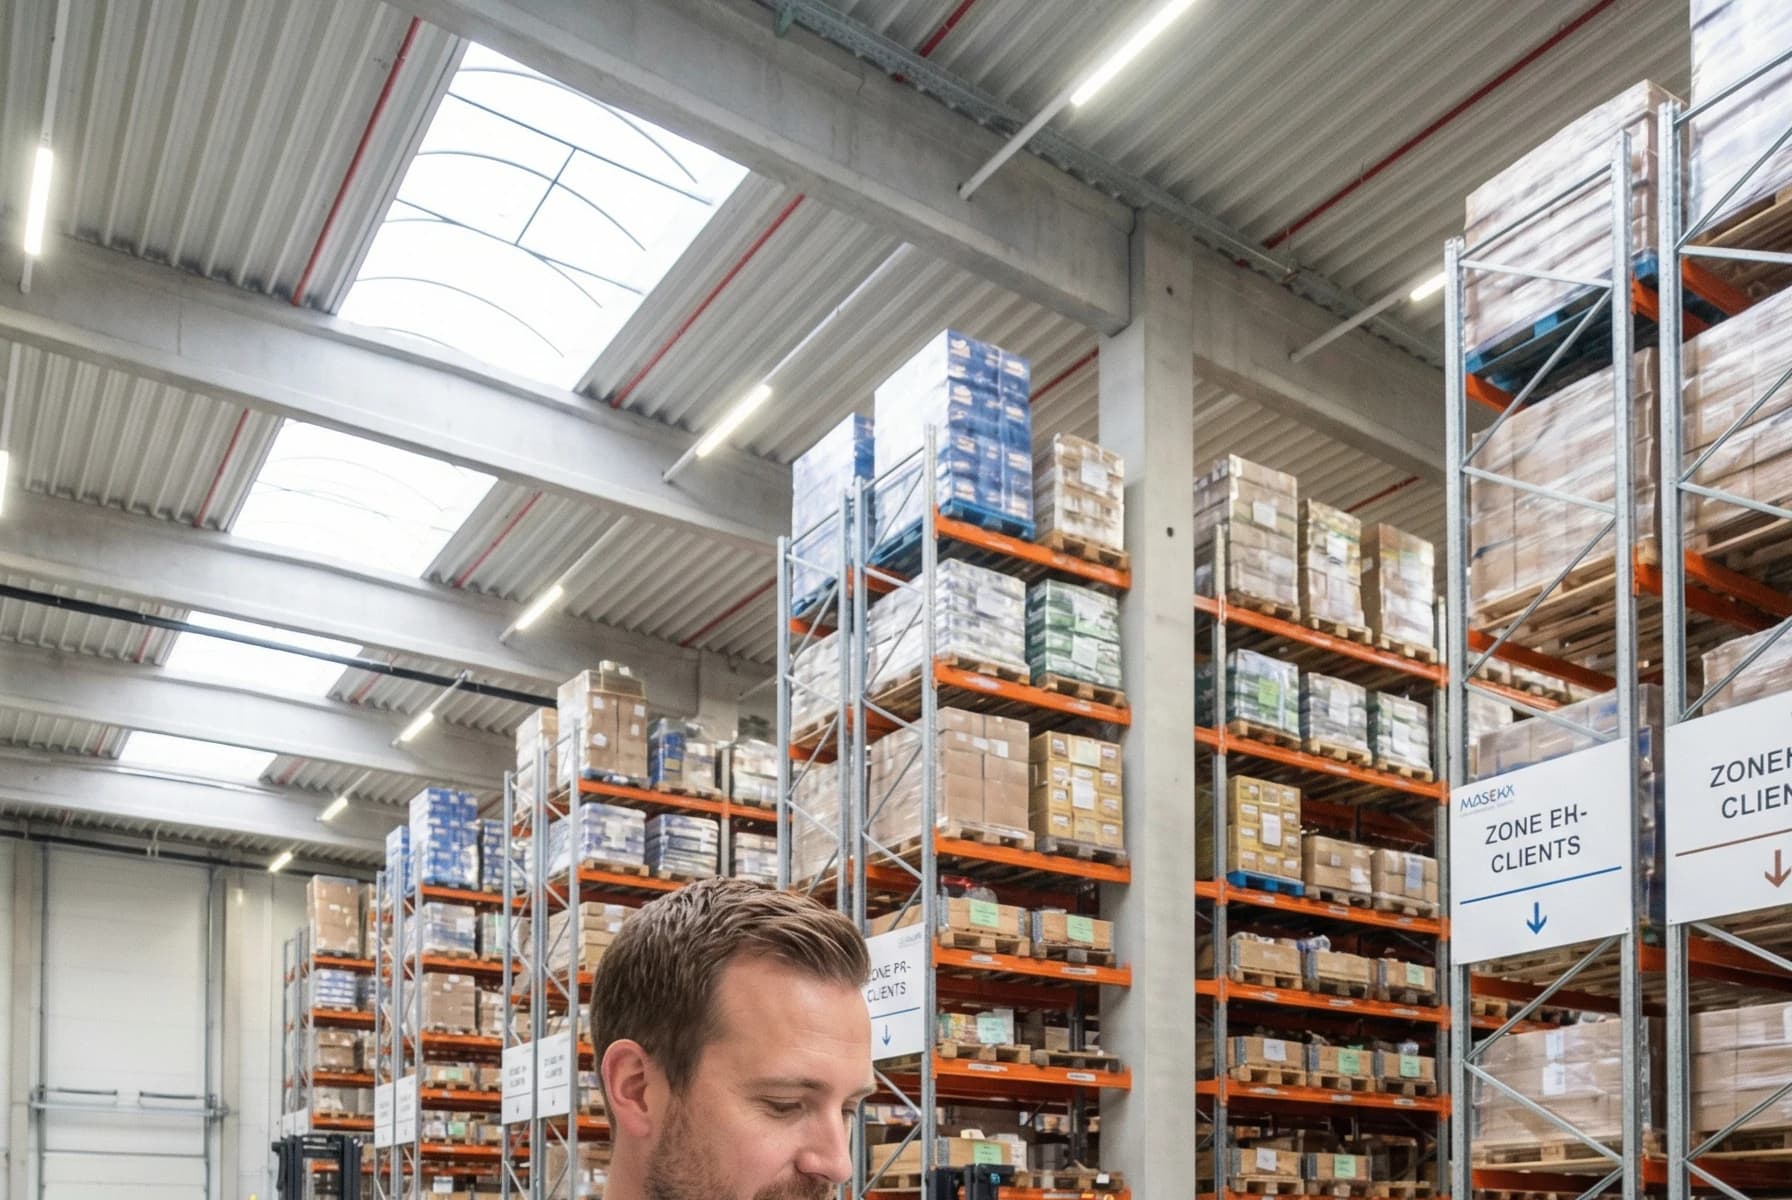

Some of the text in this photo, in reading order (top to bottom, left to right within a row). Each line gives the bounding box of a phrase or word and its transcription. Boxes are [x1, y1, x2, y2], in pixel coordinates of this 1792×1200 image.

[1485, 804, 1587, 845] ZONE EH-
[1491, 835, 1581, 873] CLIENTS
[872, 964, 891, 981] ONE
[867, 981, 906, 1003] CLIENTS
